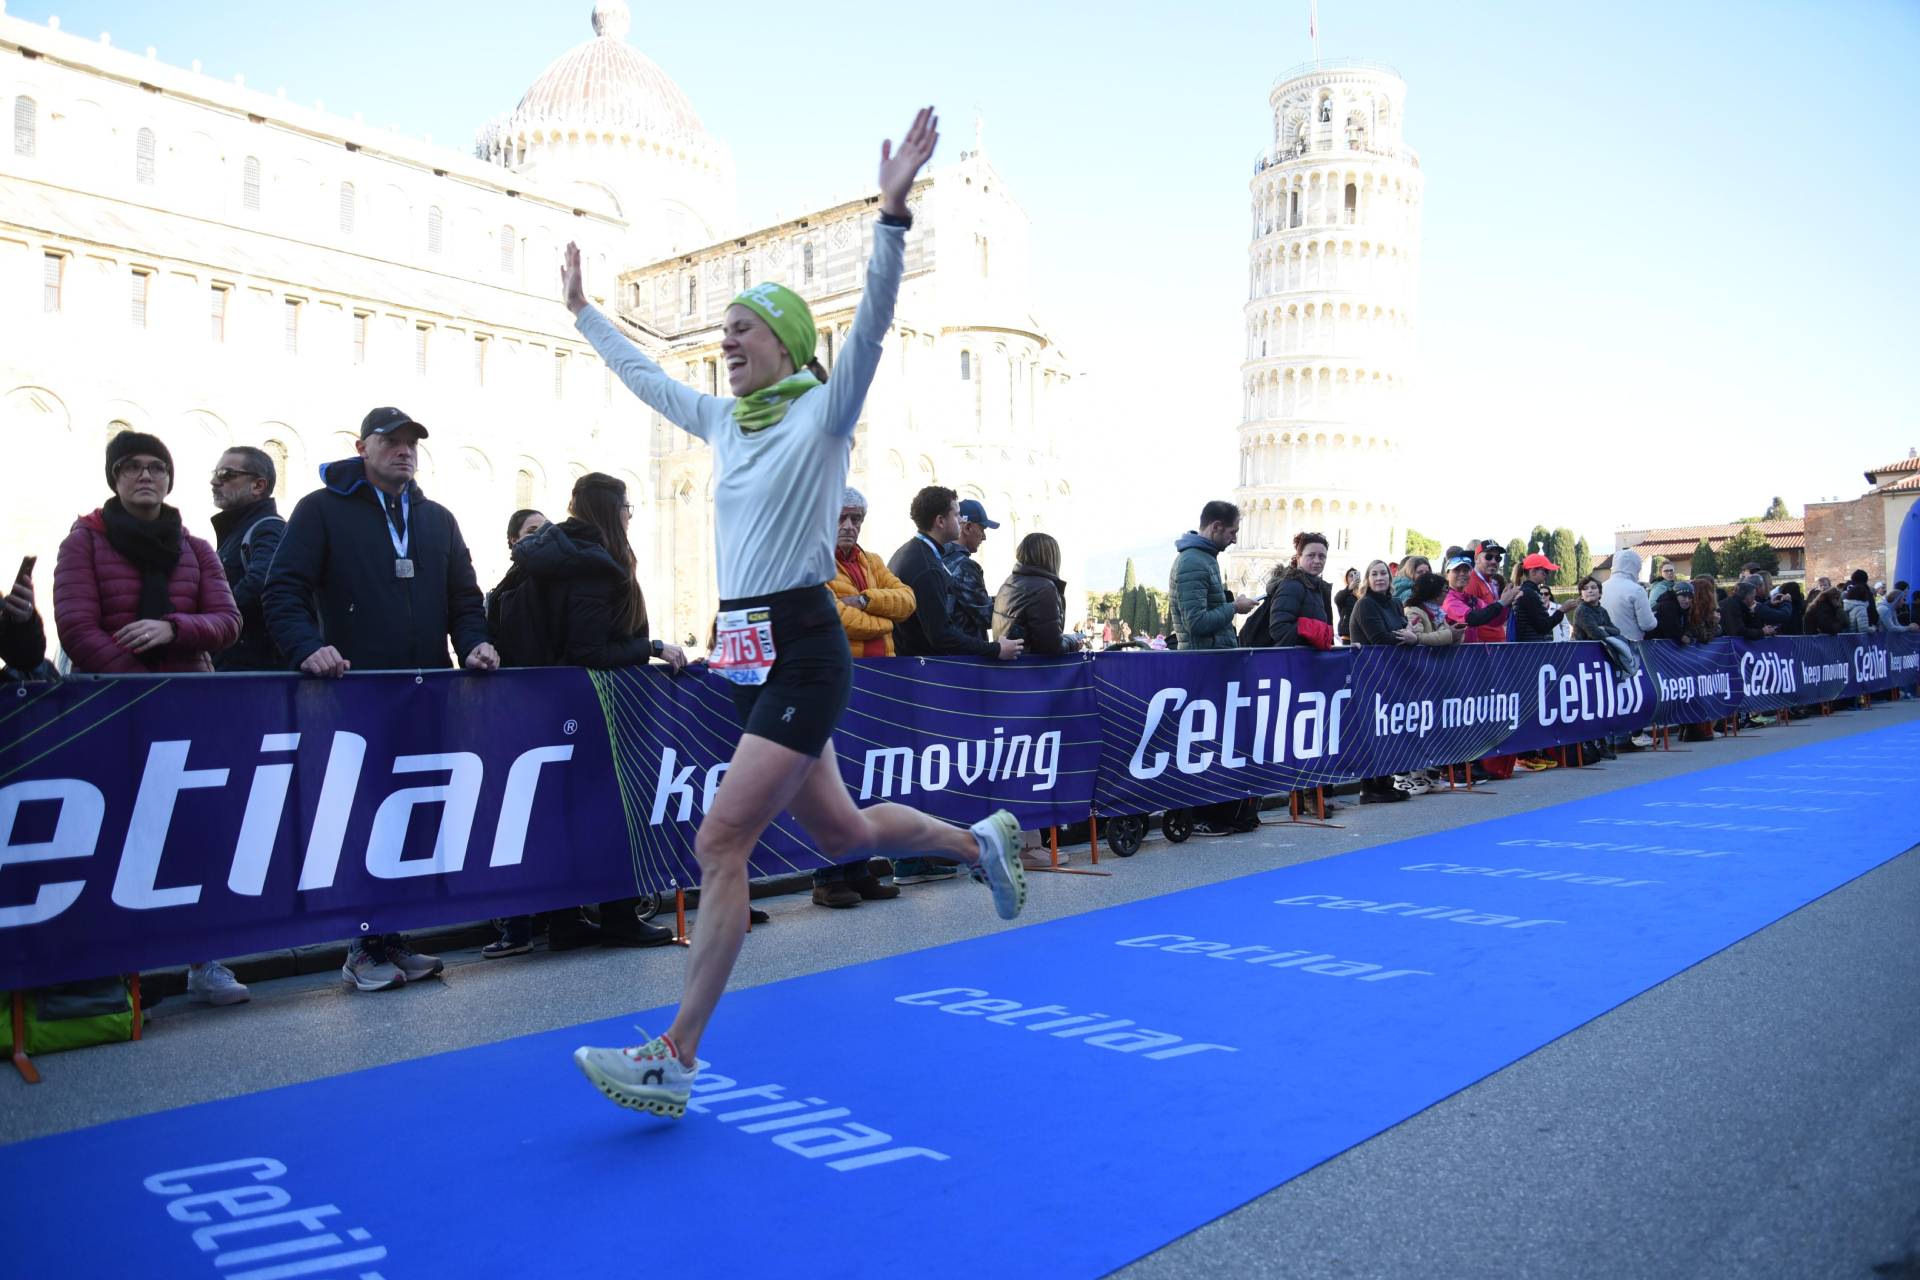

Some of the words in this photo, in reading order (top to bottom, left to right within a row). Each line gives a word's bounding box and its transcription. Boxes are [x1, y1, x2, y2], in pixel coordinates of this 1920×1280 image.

[1656, 672, 1695, 702] keep
[1697, 668, 1731, 700] moving
[1740, 651, 1796, 696] Cetilar
[1802, 661, 1821, 685] keep
[1822, 660, 1849, 684] moving
[1855, 644, 1887, 682] Cetilar
[1375, 692, 1435, 738] keep
[1442, 688, 1520, 731] moving
[1538, 661, 1644, 727] Cetilar
[1128, 678, 1352, 780] Cetilar
[649, 747, 732, 826] ke
[860, 727, 1062, 801] moving
[0, 730, 575, 927] etilar
[1273, 894, 1567, 929] Cetilar
[1115, 933, 1435, 982] Cetilar
[894, 987, 1240, 1061] Cetilar
[686, 1057, 951, 1172] etilar
[143, 1156, 388, 1280] Cetil
